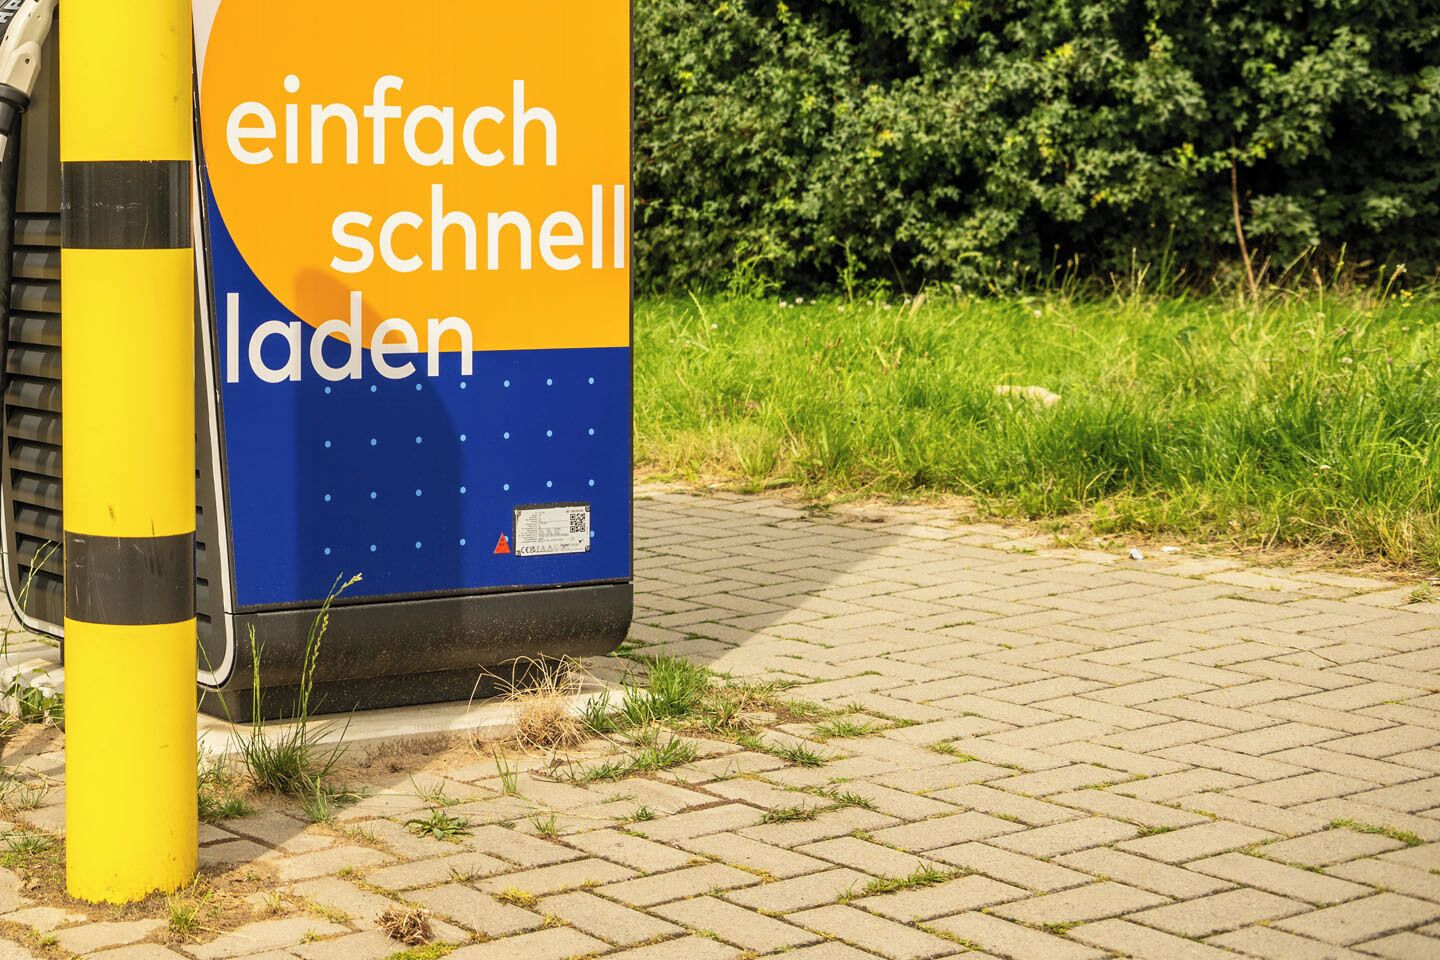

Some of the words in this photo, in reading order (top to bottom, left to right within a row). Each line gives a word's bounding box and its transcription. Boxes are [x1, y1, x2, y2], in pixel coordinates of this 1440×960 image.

[226, 74, 557, 167] einfach
[330, 184, 625, 273] schnell
[226, 291, 473, 383] laden
